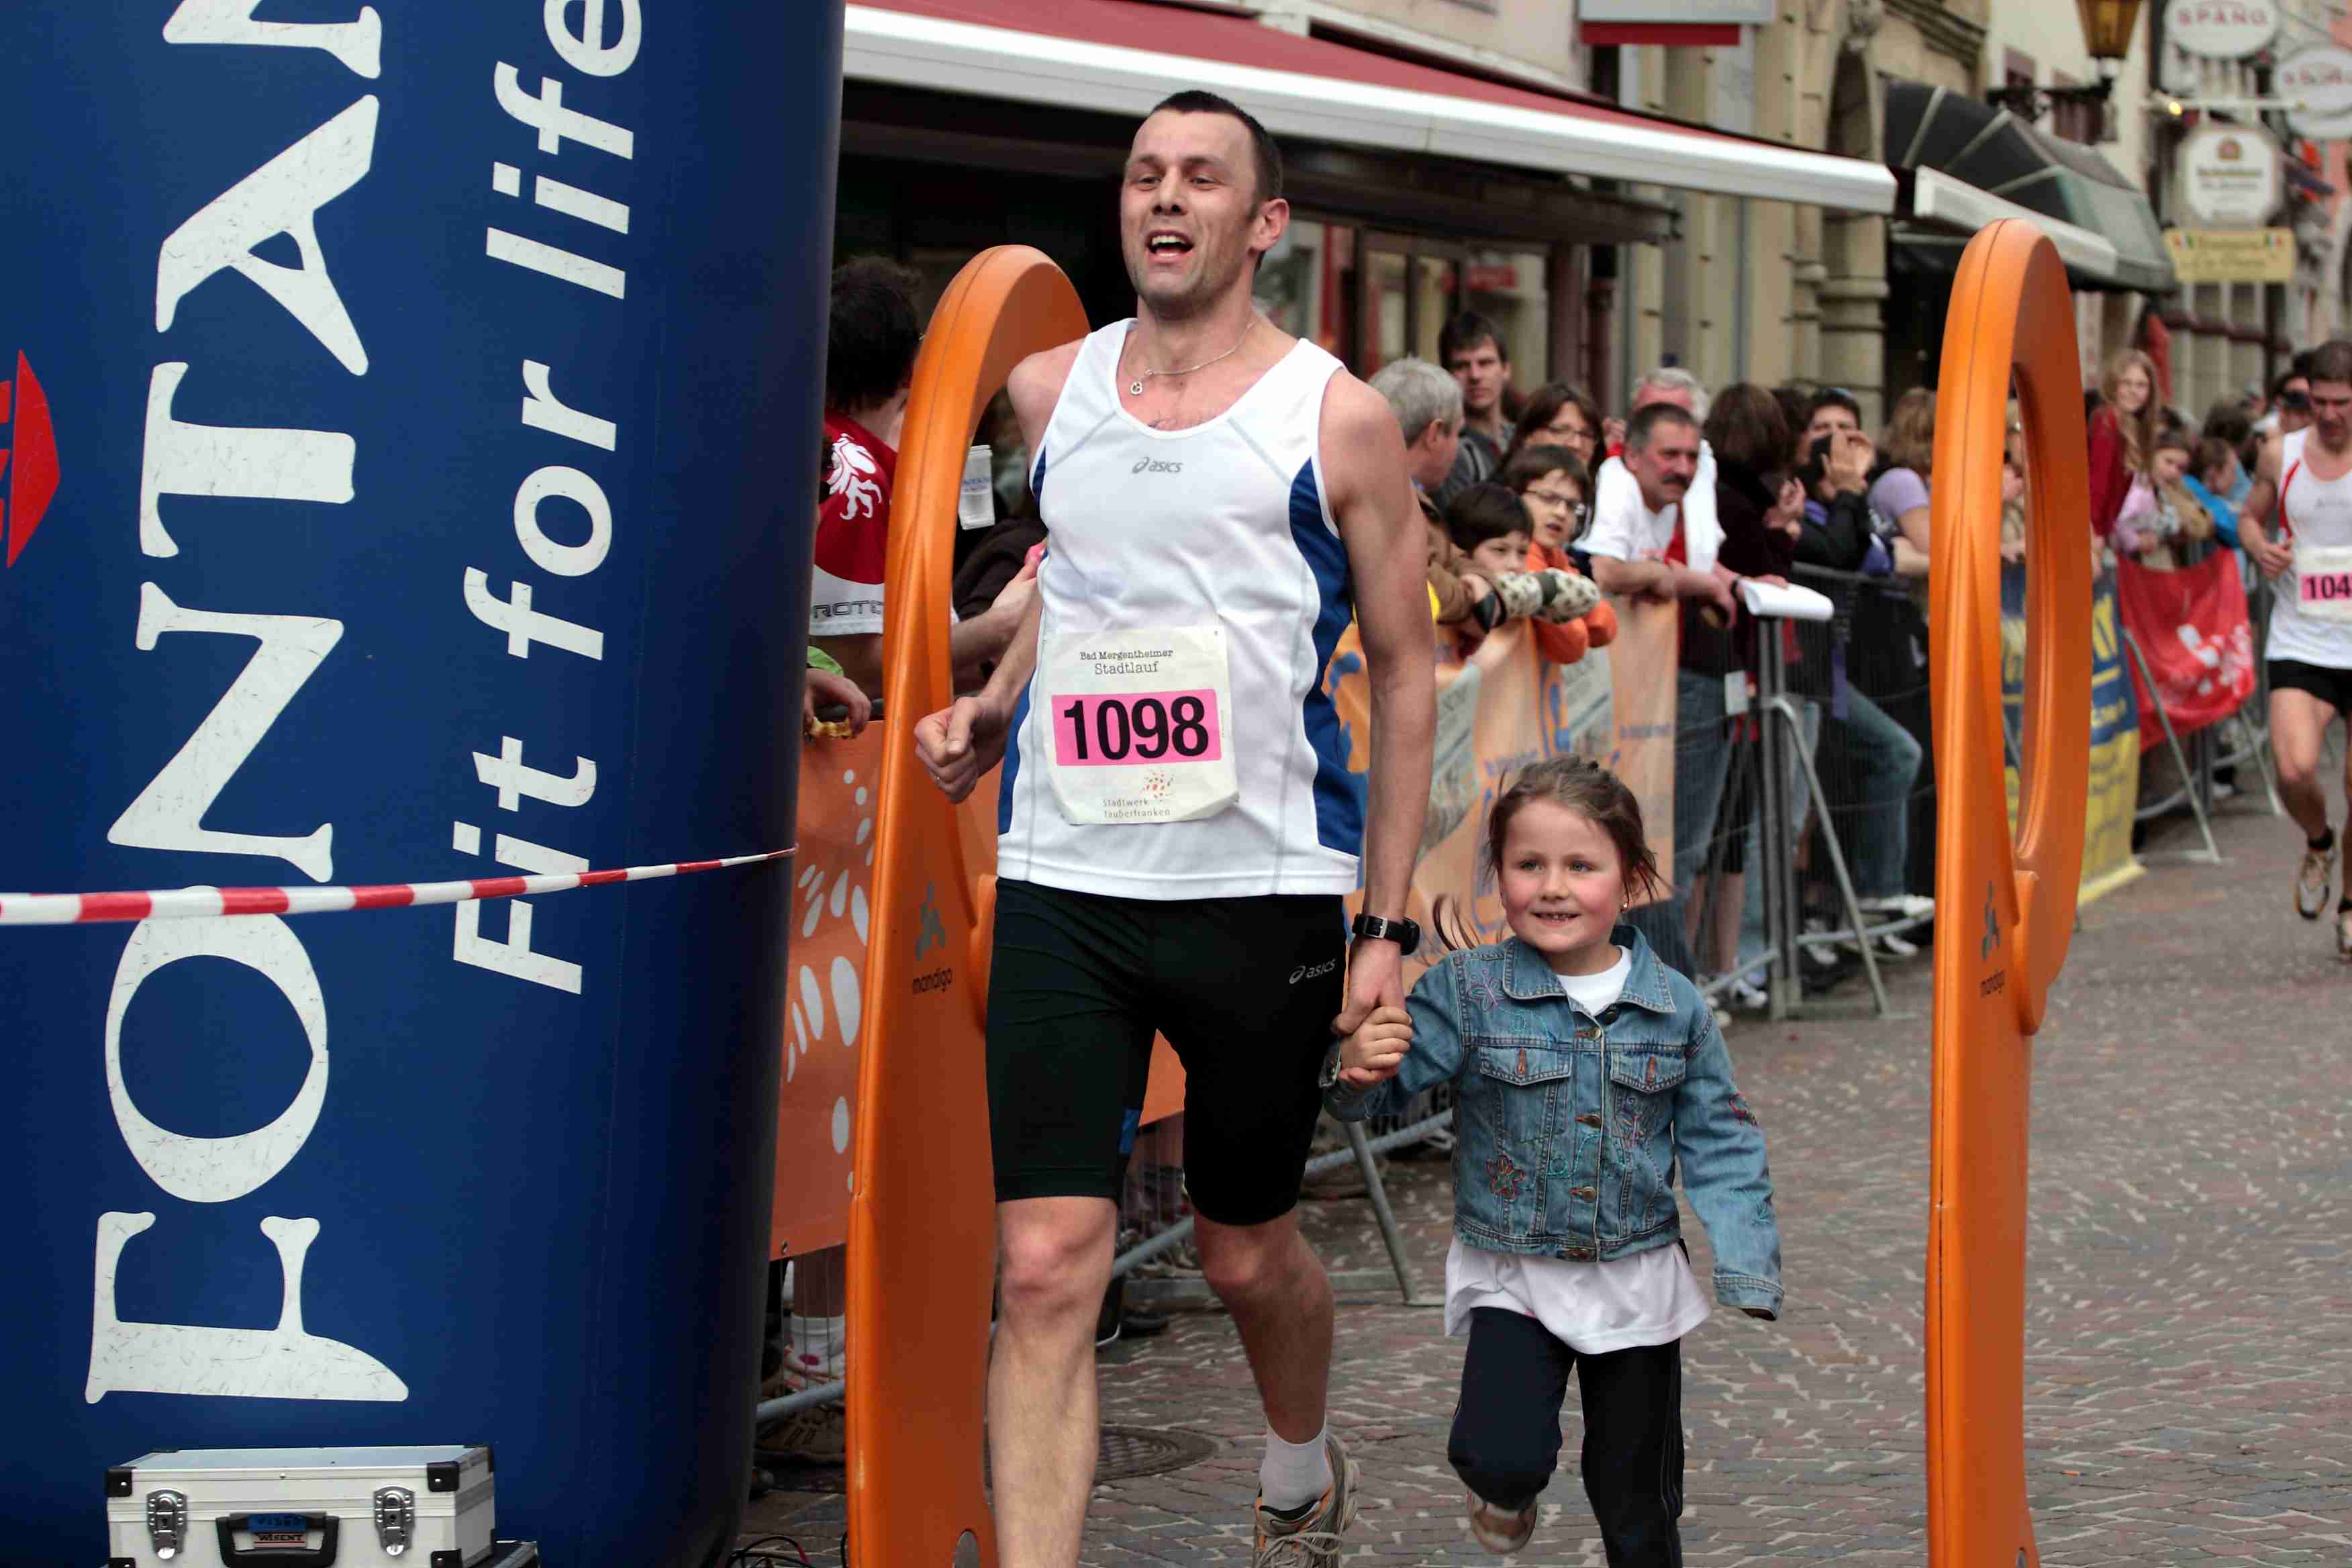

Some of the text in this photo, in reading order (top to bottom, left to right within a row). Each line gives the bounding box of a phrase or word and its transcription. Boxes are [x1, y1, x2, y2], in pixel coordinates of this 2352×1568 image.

[453, 0, 641, 994] Fit for life
[1080, 648, 1173, 661] Bad Mergentheimer
[1095, 661, 1160, 675] Stadtlauf
[85, 0, 408, 1404] FONTA
[1064, 696, 1209, 761] 1098
